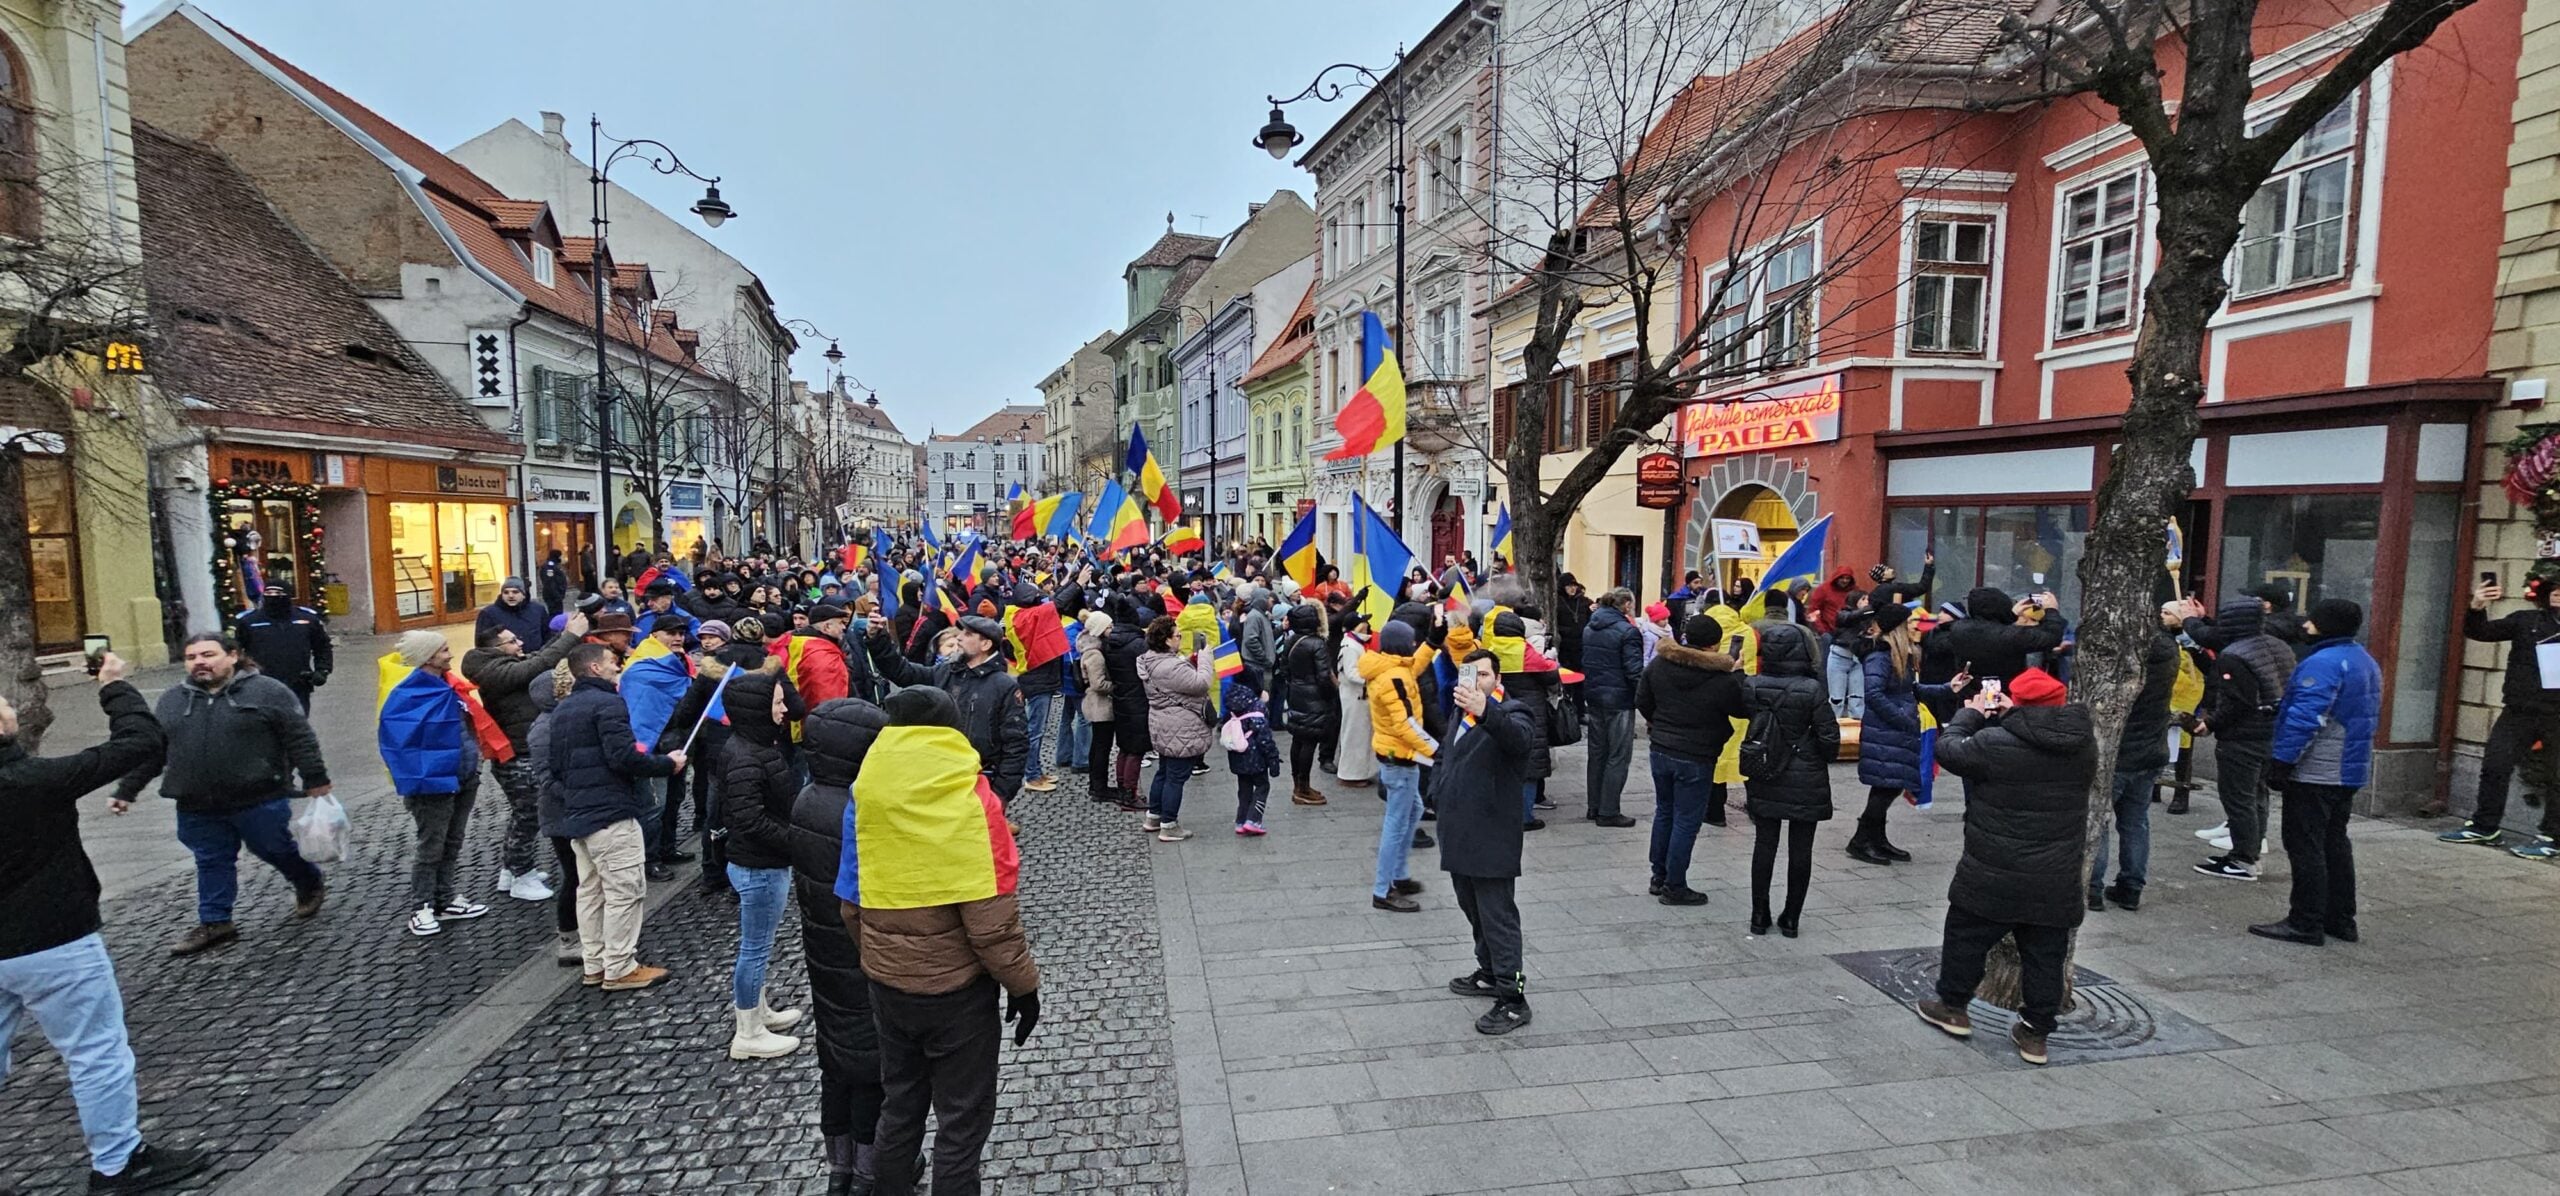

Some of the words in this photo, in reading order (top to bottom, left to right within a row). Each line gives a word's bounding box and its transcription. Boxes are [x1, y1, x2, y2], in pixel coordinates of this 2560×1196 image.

[1744, 379, 1835, 424] comerciale
[1698, 420, 1811, 452] PACEA
[458, 474, 485, 488] black
[486, 478, 500, 489] cat
